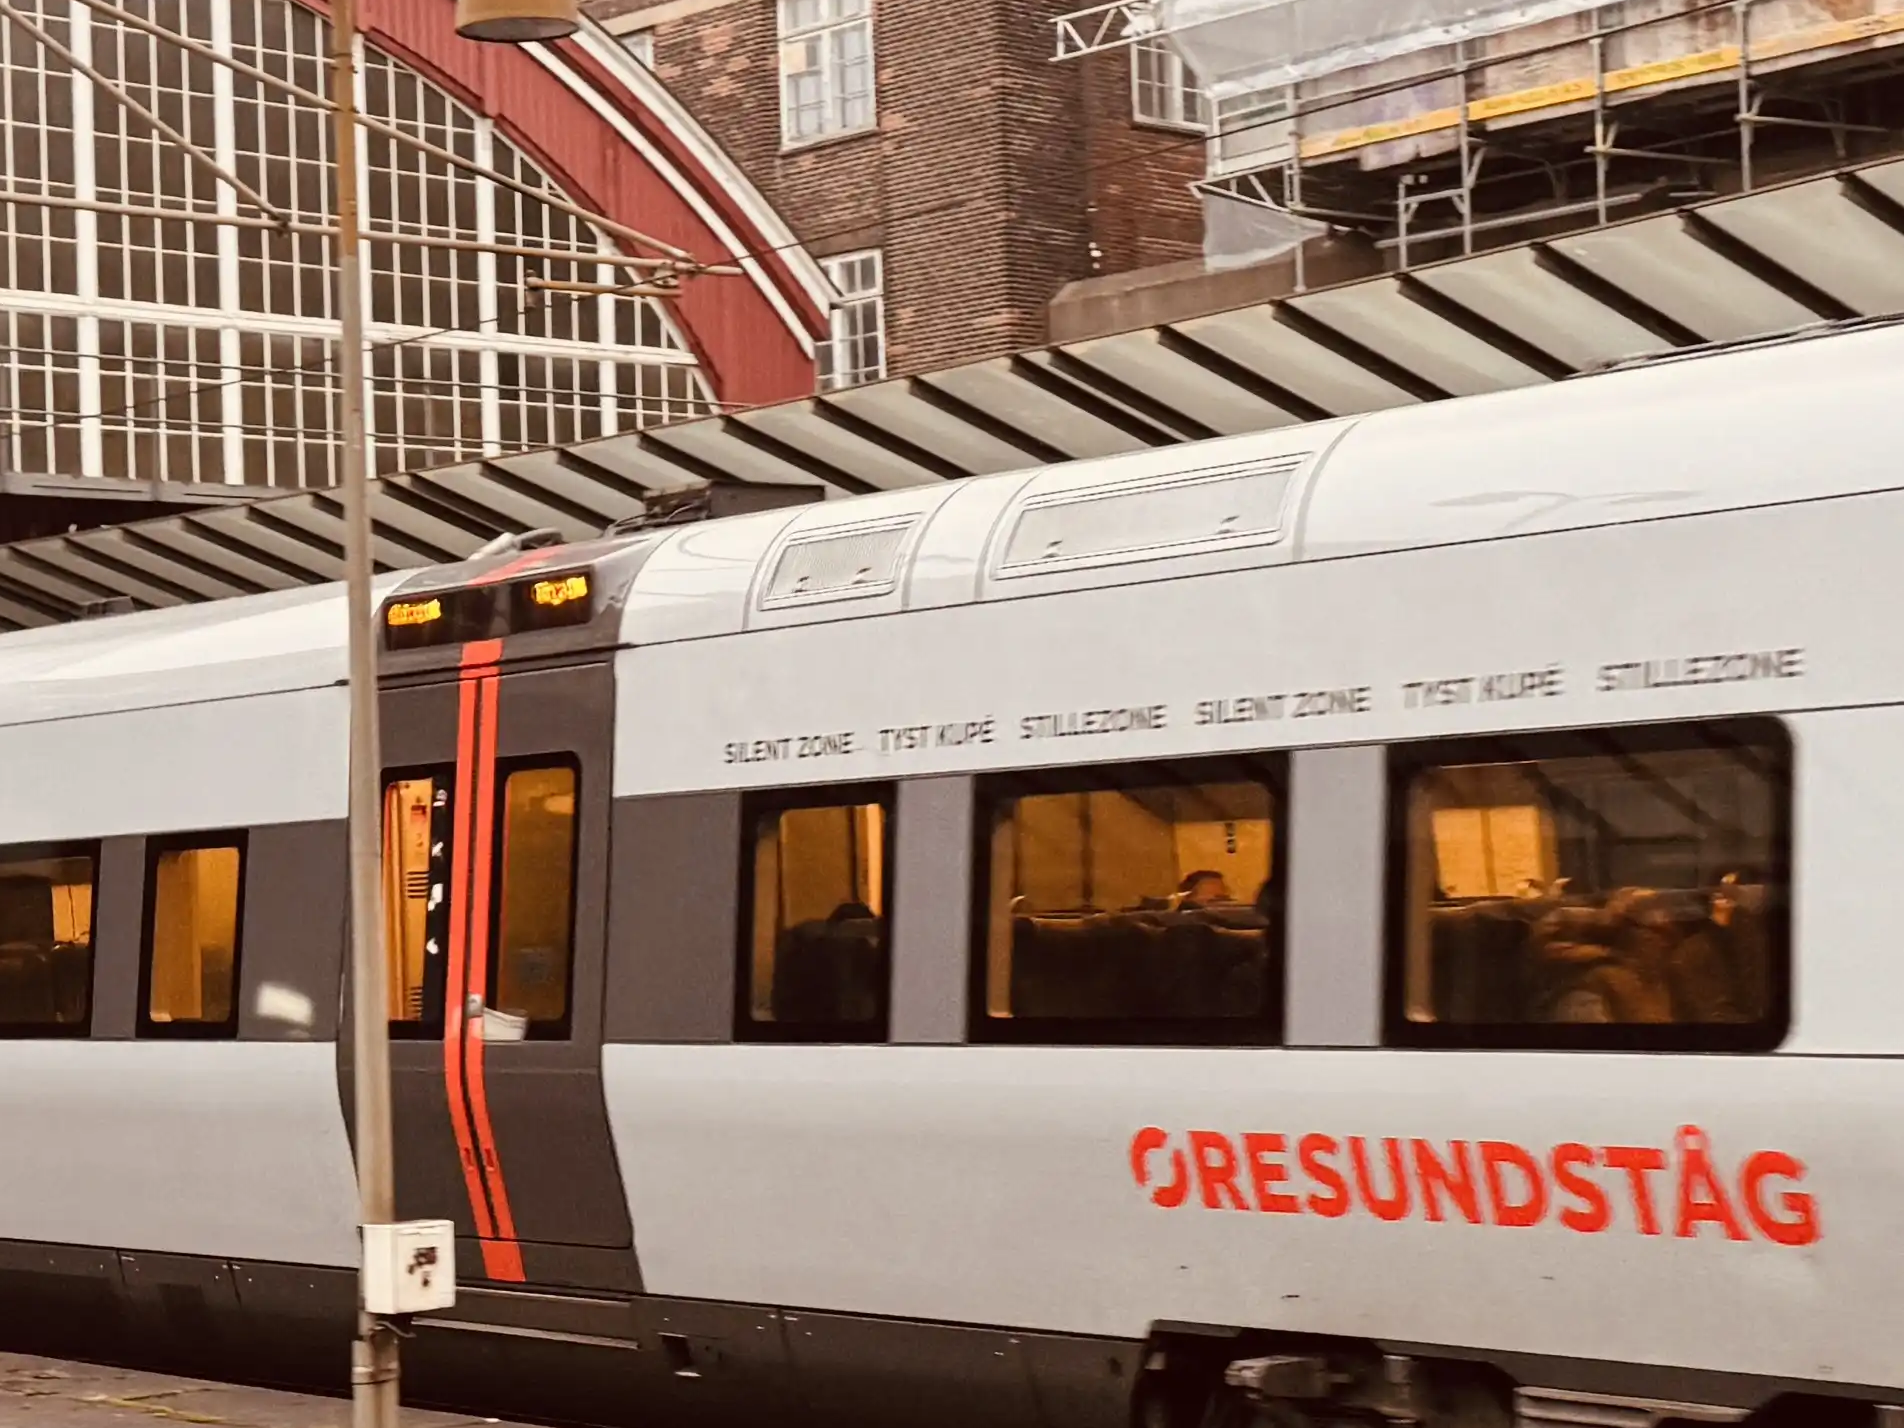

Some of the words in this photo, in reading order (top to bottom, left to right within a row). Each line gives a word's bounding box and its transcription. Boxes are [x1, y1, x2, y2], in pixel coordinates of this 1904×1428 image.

[724, 735, 791, 765] SILENT
[797, 731, 855, 759] ZONE
[878, 726, 931, 754] TYST
[935, 714, 995, 746] KUPÉ
[1019, 703, 1168, 740] STILLEZONE
[1195, 693, 1288, 726] SILENT
[1291, 687, 1371, 719] ZONE
[1402, 676, 1476, 708] TYST
[1478, 663, 1566, 700] KUPÉ
[1596, 648, 1805, 693] STILLEZONE
[1130, 1123, 1821, 1247] ØRESUNDSTÅG
